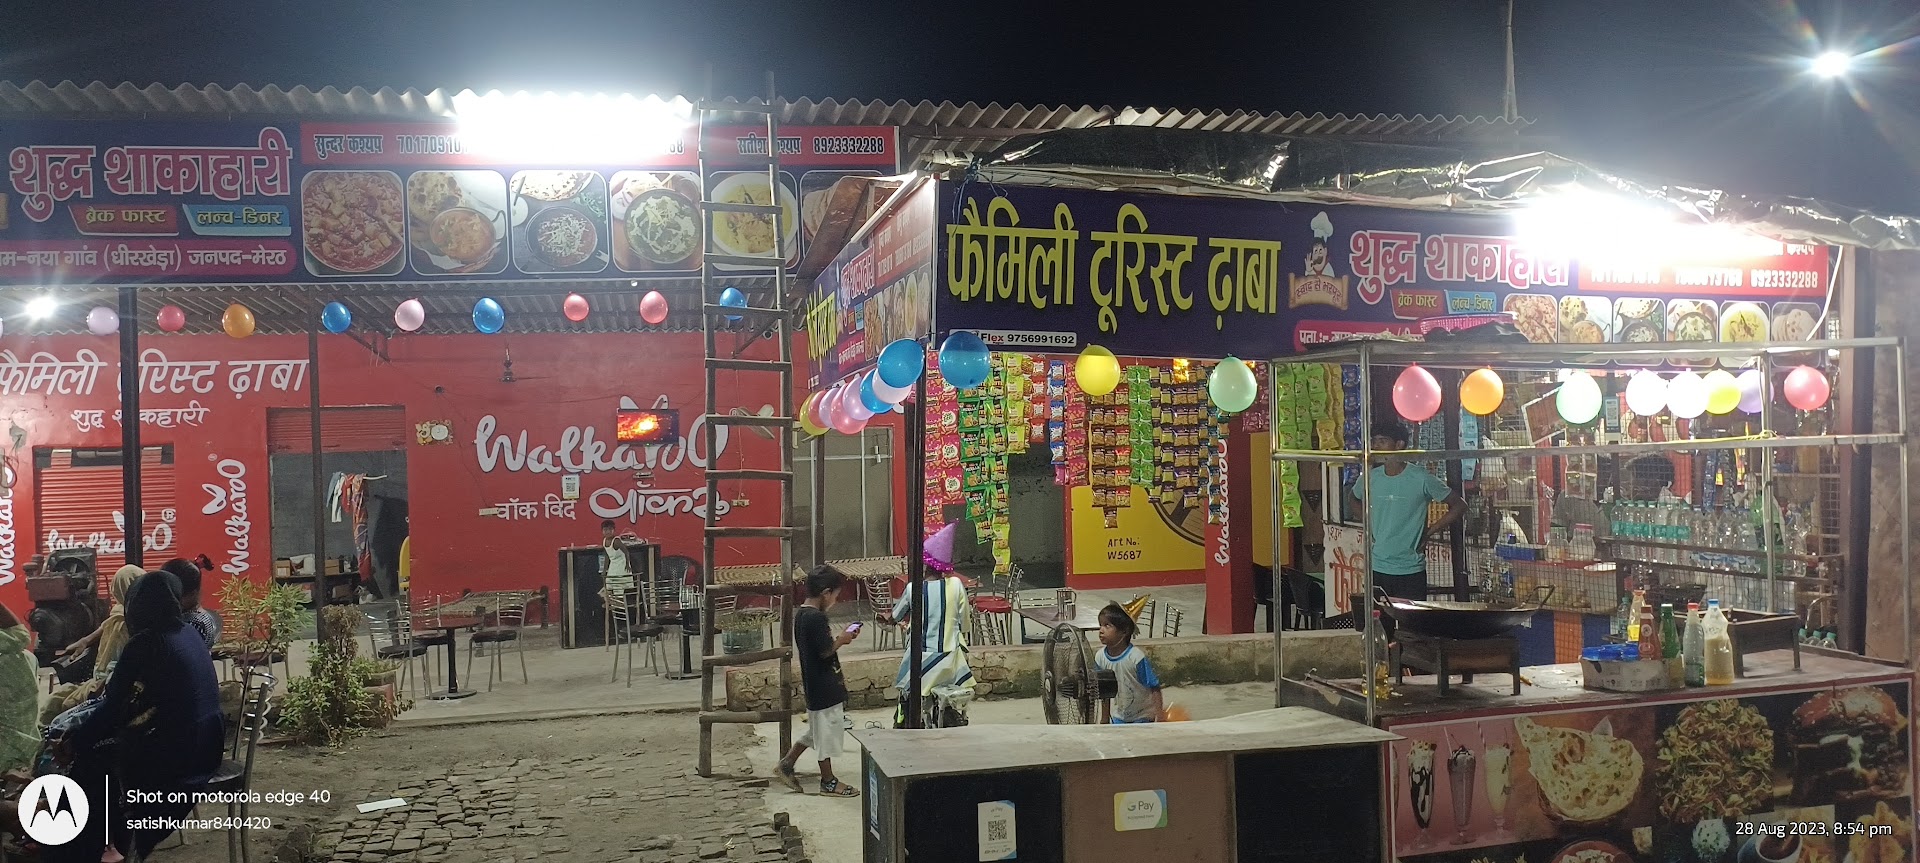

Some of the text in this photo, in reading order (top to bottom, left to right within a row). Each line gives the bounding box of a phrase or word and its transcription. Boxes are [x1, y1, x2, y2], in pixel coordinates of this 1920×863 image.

[347, 134, 383, 154] कश्यप
[813, 136, 884, 154] 8923332288
[9, 126, 293, 222] शुद्ध शाकाहारी
[946, 196, 1282, 334] फैमिली टूरिस्ट ढ़ाबा
[1350, 230, 1421, 304] शुद्ध
[981, 333, 1075, 344] Flex 9756991692
[228, 359, 309, 400] ढ़ाबा
[495, 497, 539, 520] वॉक
[541, 493, 578, 520] विद
[1107, 537, 1124, 547] Art
[1107, 550, 1142, 560] W5687
[1138, 800, 1155, 812] Pay
